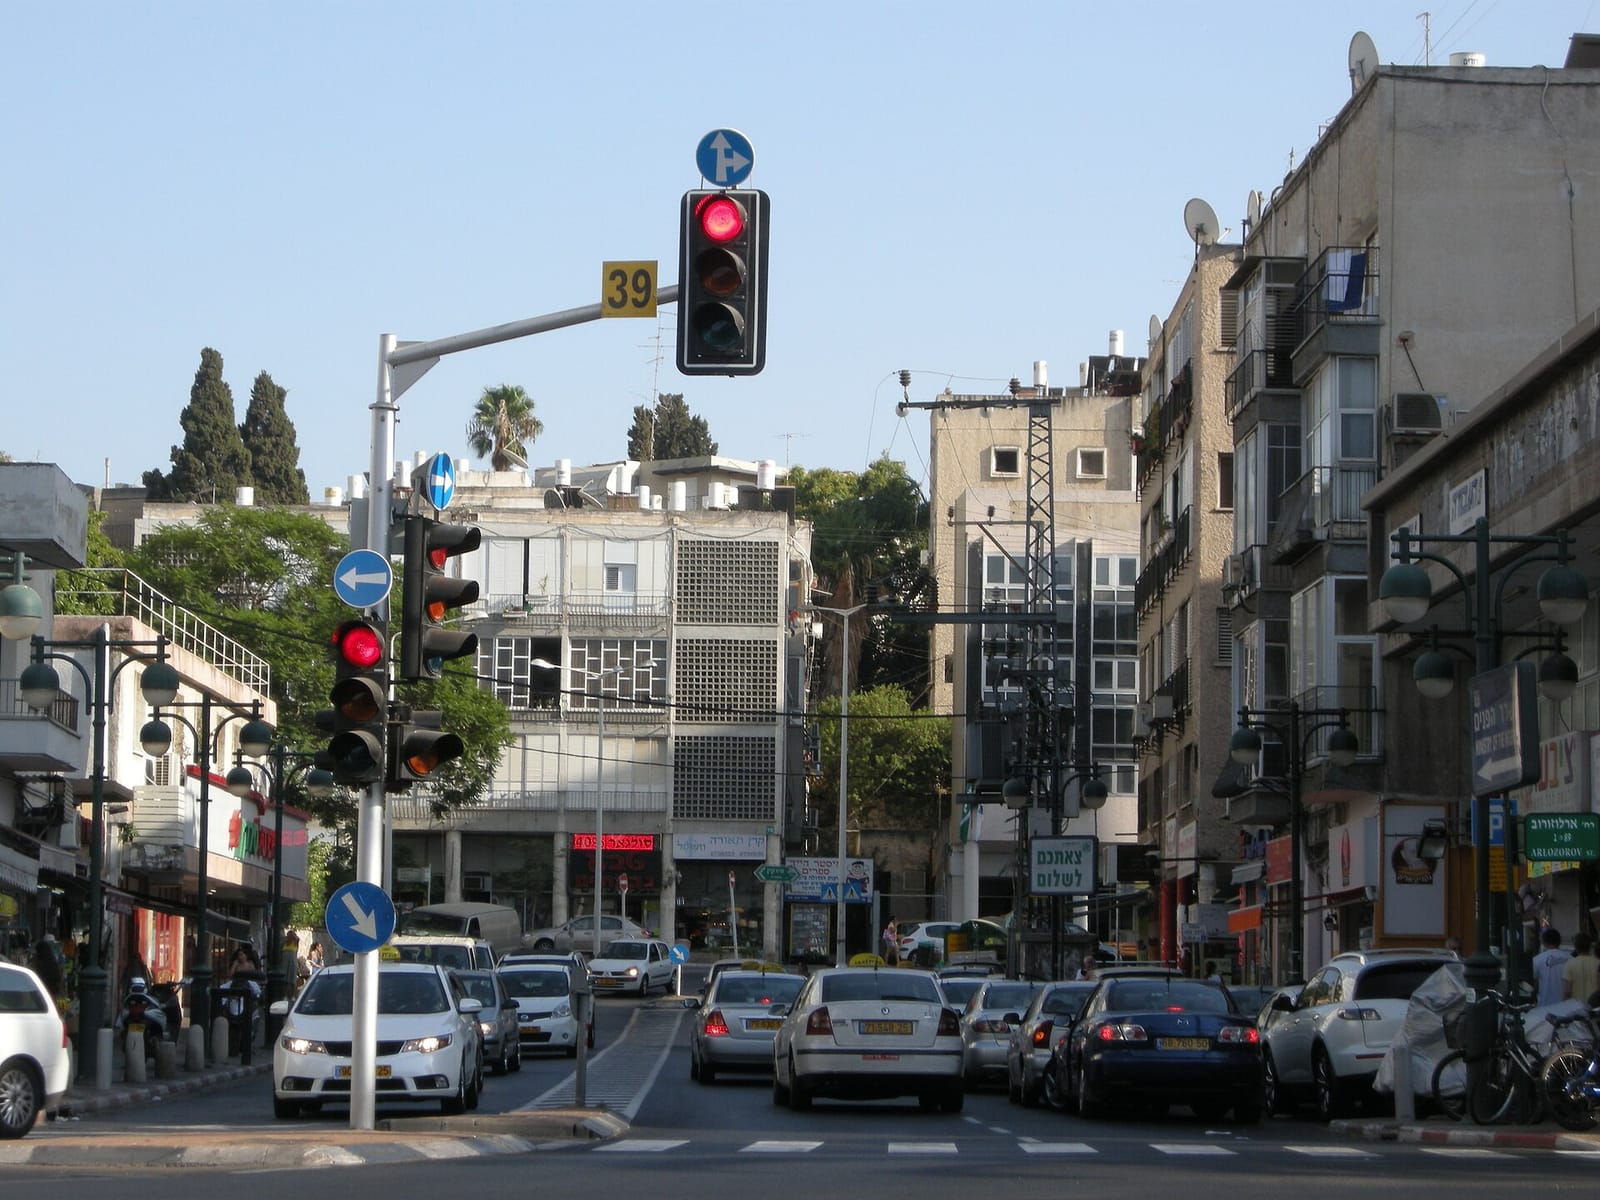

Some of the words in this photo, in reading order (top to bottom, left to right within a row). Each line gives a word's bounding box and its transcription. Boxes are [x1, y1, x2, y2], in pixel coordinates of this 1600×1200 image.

[607, 269, 652, 310] 39
[1474, 707, 1496, 732] הפנים
[1531, 817, 1578, 830] ארלוזורוב
[710, 836, 744, 845] תאורה
[748, 836, 765, 847] קרן
[1037, 850, 1082, 865] צאתכם
[1531, 847, 1583, 857] ARLOZOROV
[1037, 868, 1082, 887] לשלום
